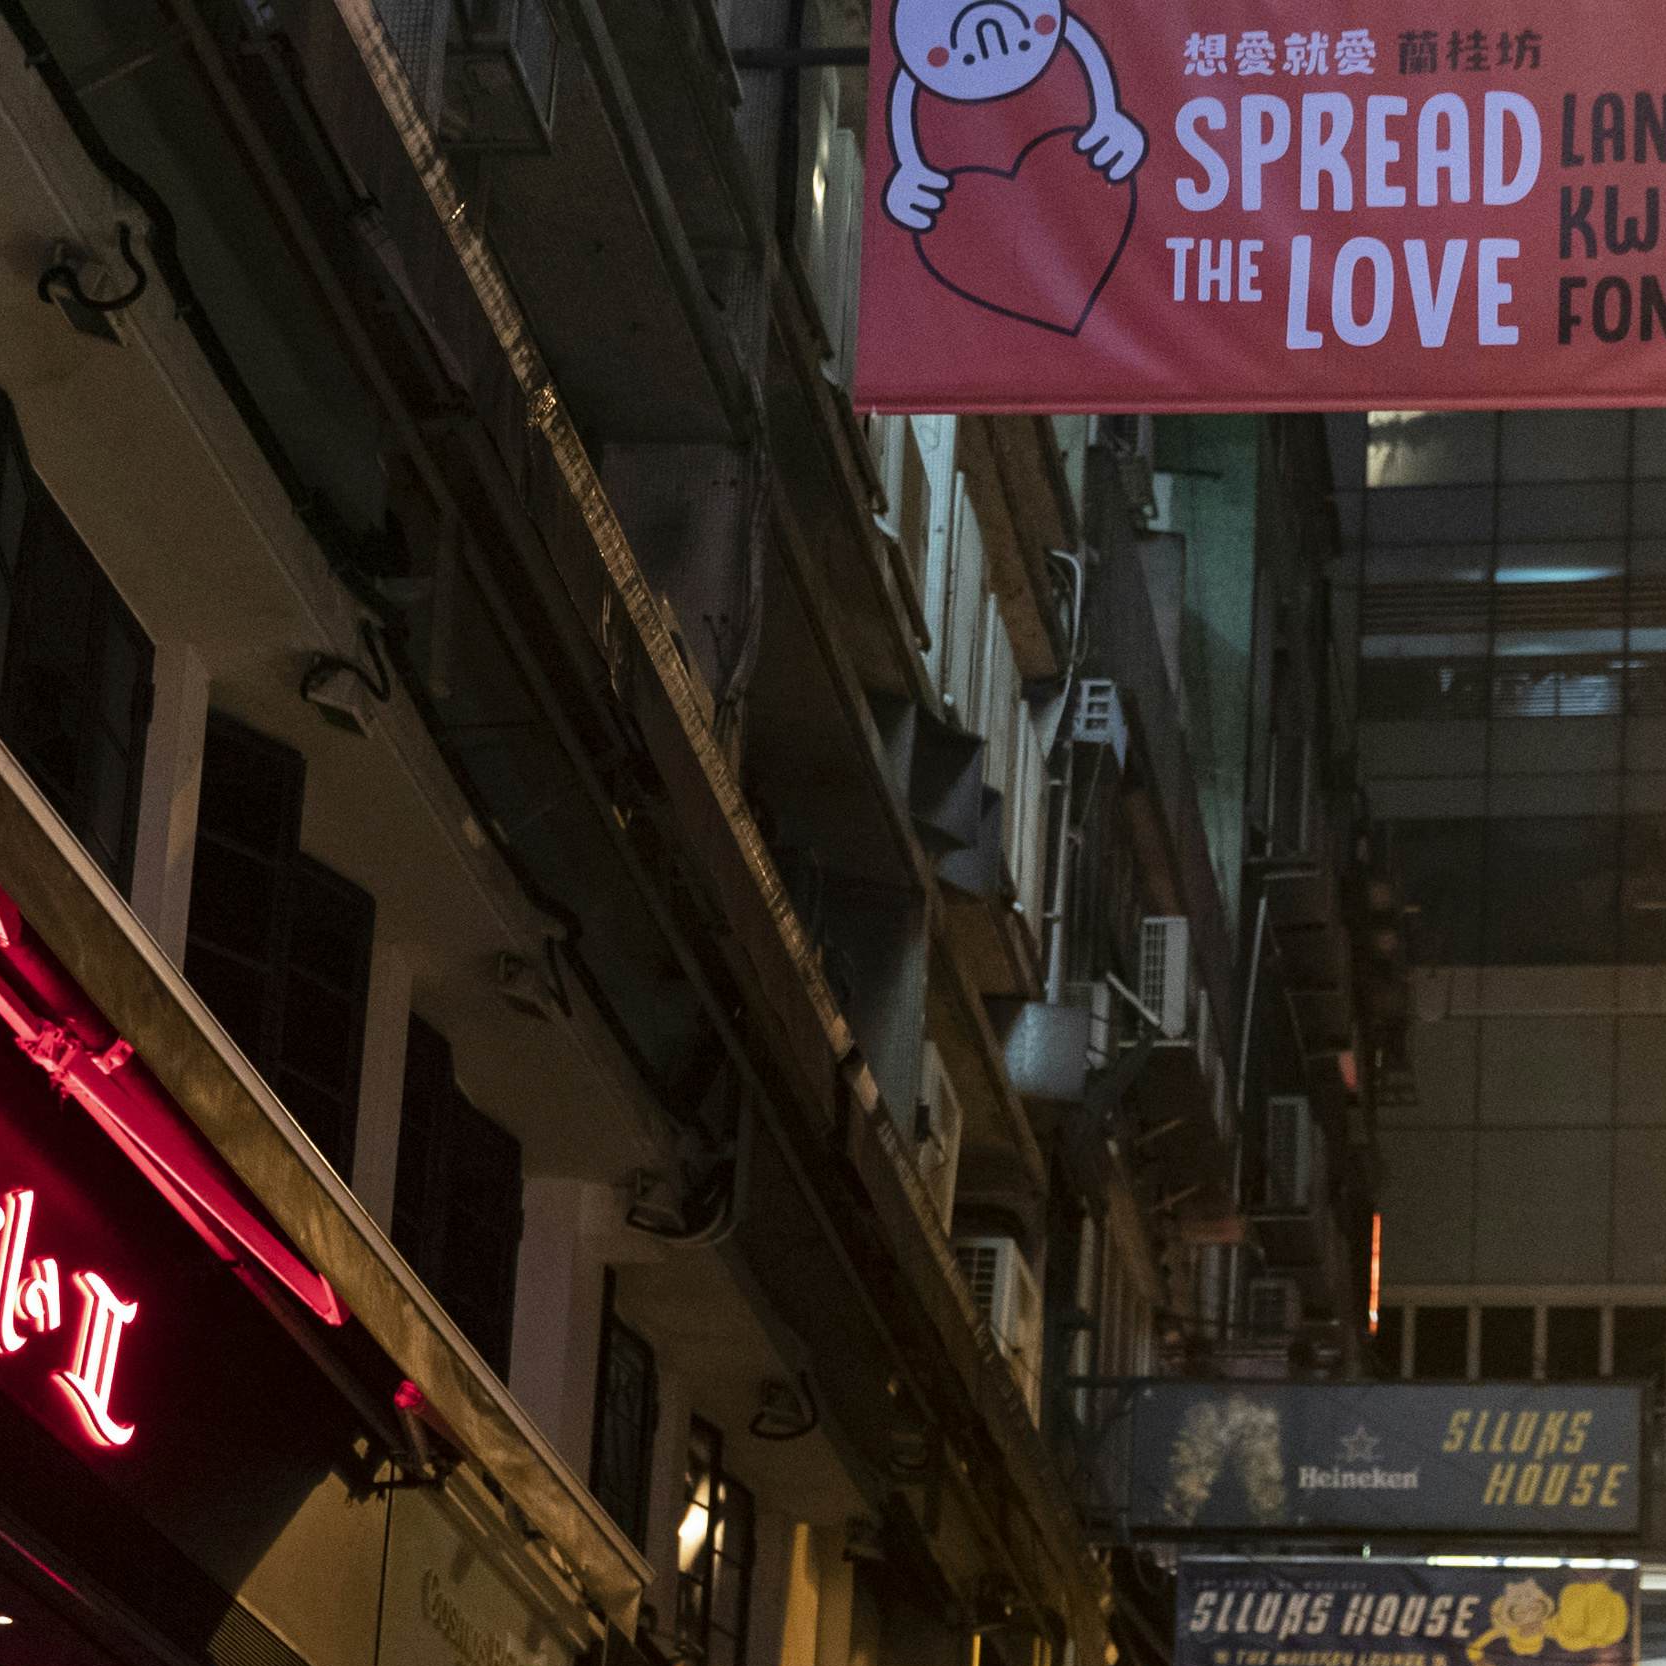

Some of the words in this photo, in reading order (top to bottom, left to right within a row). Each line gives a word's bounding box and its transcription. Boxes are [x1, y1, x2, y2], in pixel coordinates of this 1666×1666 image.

[1183, 30, 1376, 77] 想愛就愛
[1398, 29, 1542, 76] 蘭桂坊
[1175, 91, 1542, 211] SPREAD
[1166, 236, 1263, 303] THE
[1286, 236, 1520, 350] LOVE
[1442, 1410, 1592, 1457] SLLUKS
[1299, 1466, 1419, 1490] Heineken
[1483, 1463, 1629, 1506] HOUSE
[1189, 1591, 1333, 1641] SLLUKS
[1340, 1594, 1481, 1638] HOUSE
